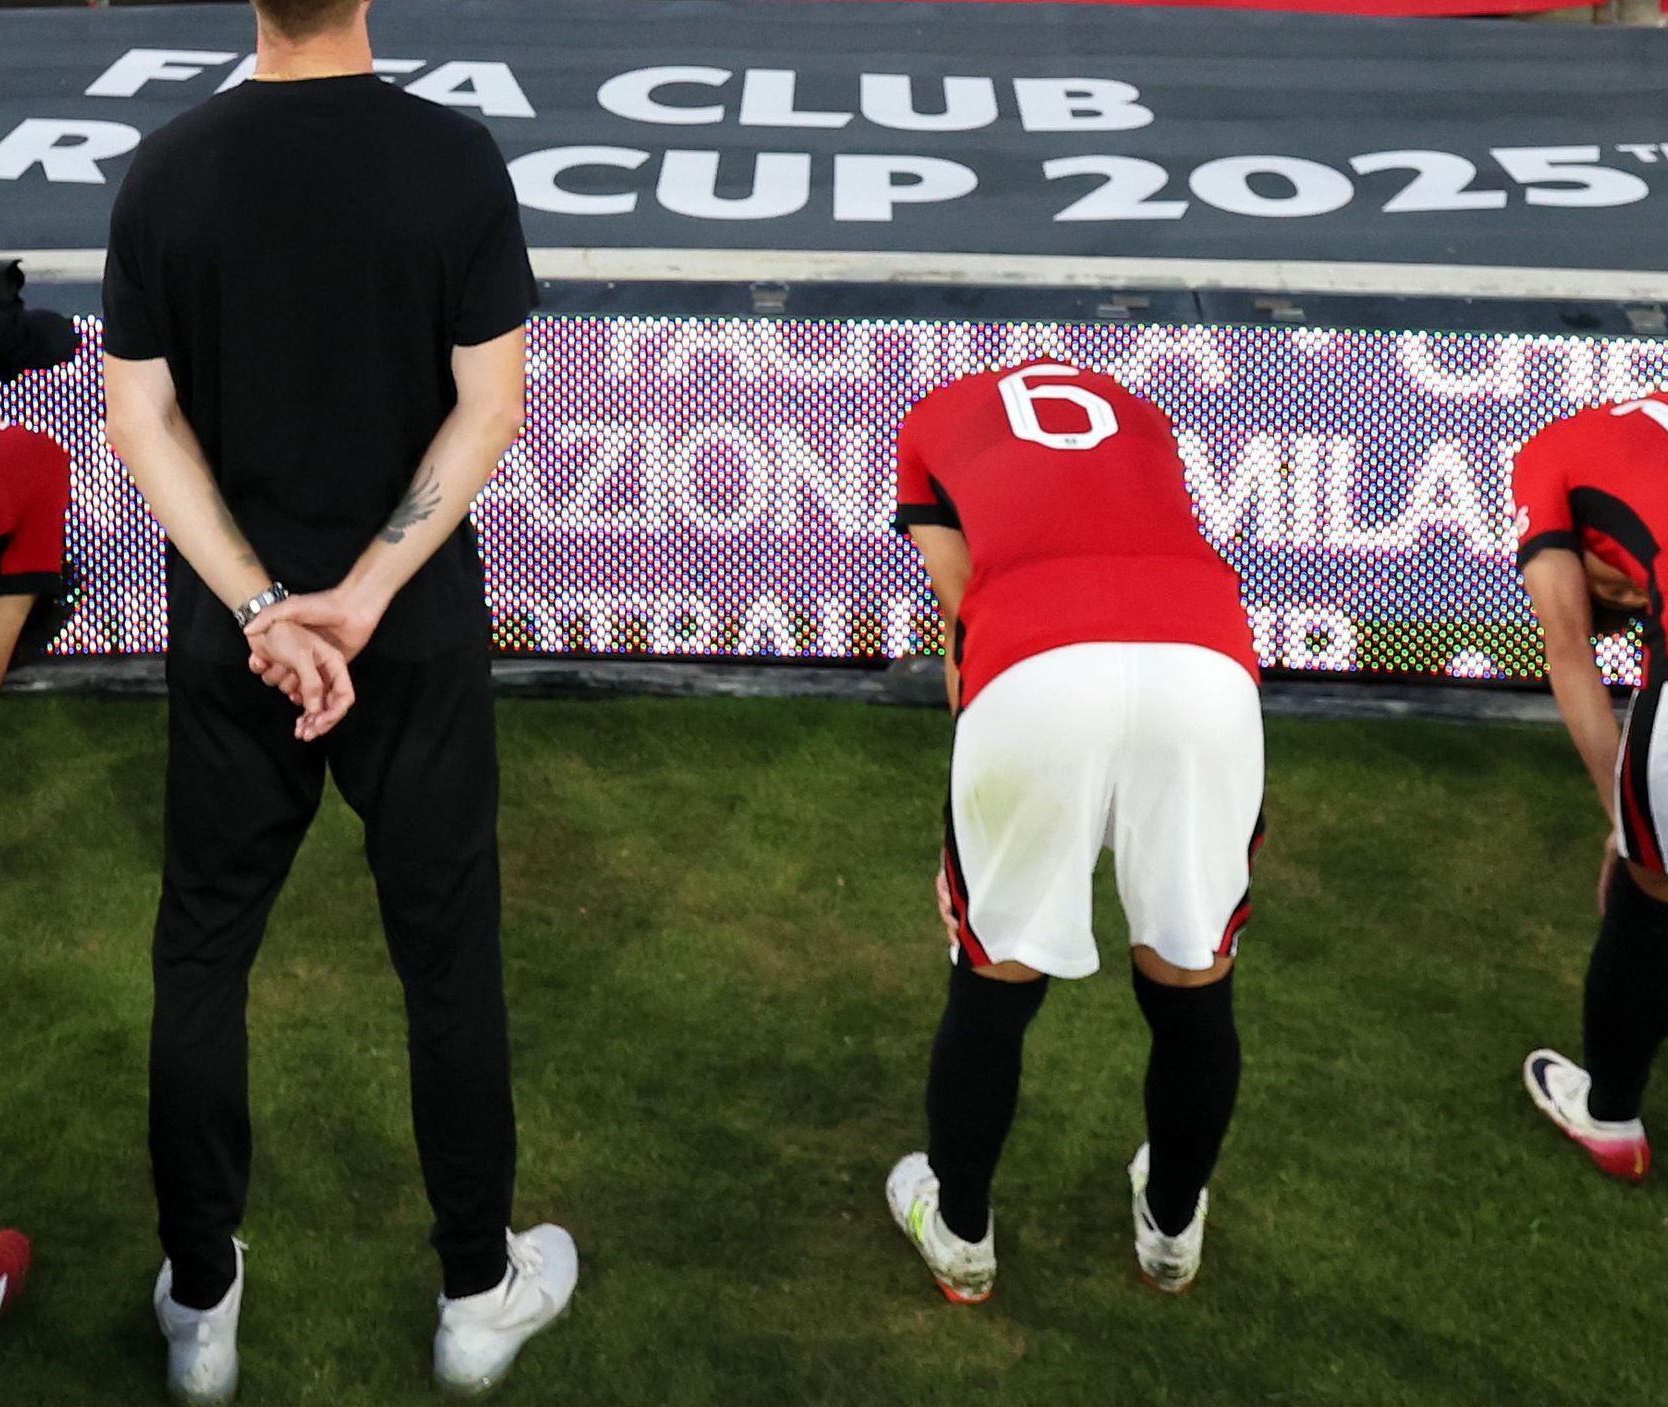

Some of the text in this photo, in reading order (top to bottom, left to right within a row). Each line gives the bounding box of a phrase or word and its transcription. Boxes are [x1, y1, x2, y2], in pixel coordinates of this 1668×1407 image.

[84, 48, 1158, 133] FA CLUB
[508, 144, 994, 221] CUP
[996, 362, 1120, 451] 6
